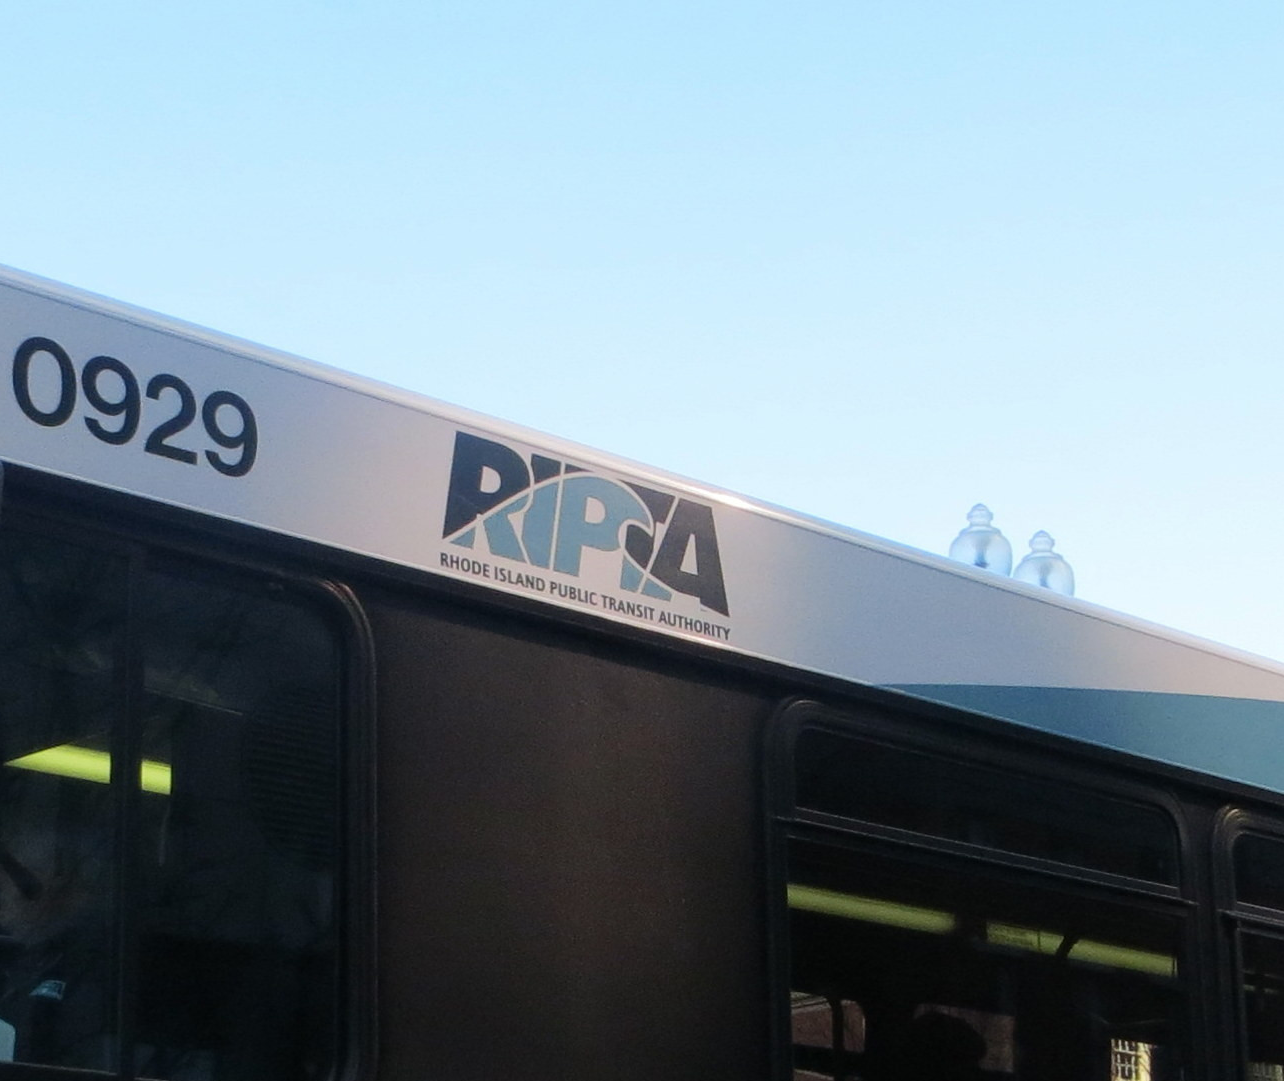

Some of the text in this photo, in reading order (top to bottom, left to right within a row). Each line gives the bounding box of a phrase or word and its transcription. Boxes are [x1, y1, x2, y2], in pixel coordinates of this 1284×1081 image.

[12, 336, 258, 478] 0929
[442, 430, 730, 618] RIPTA
[440, 553, 731, 641] RHODE ISLAND PUBLIC TRANSIT AUTHORITY
